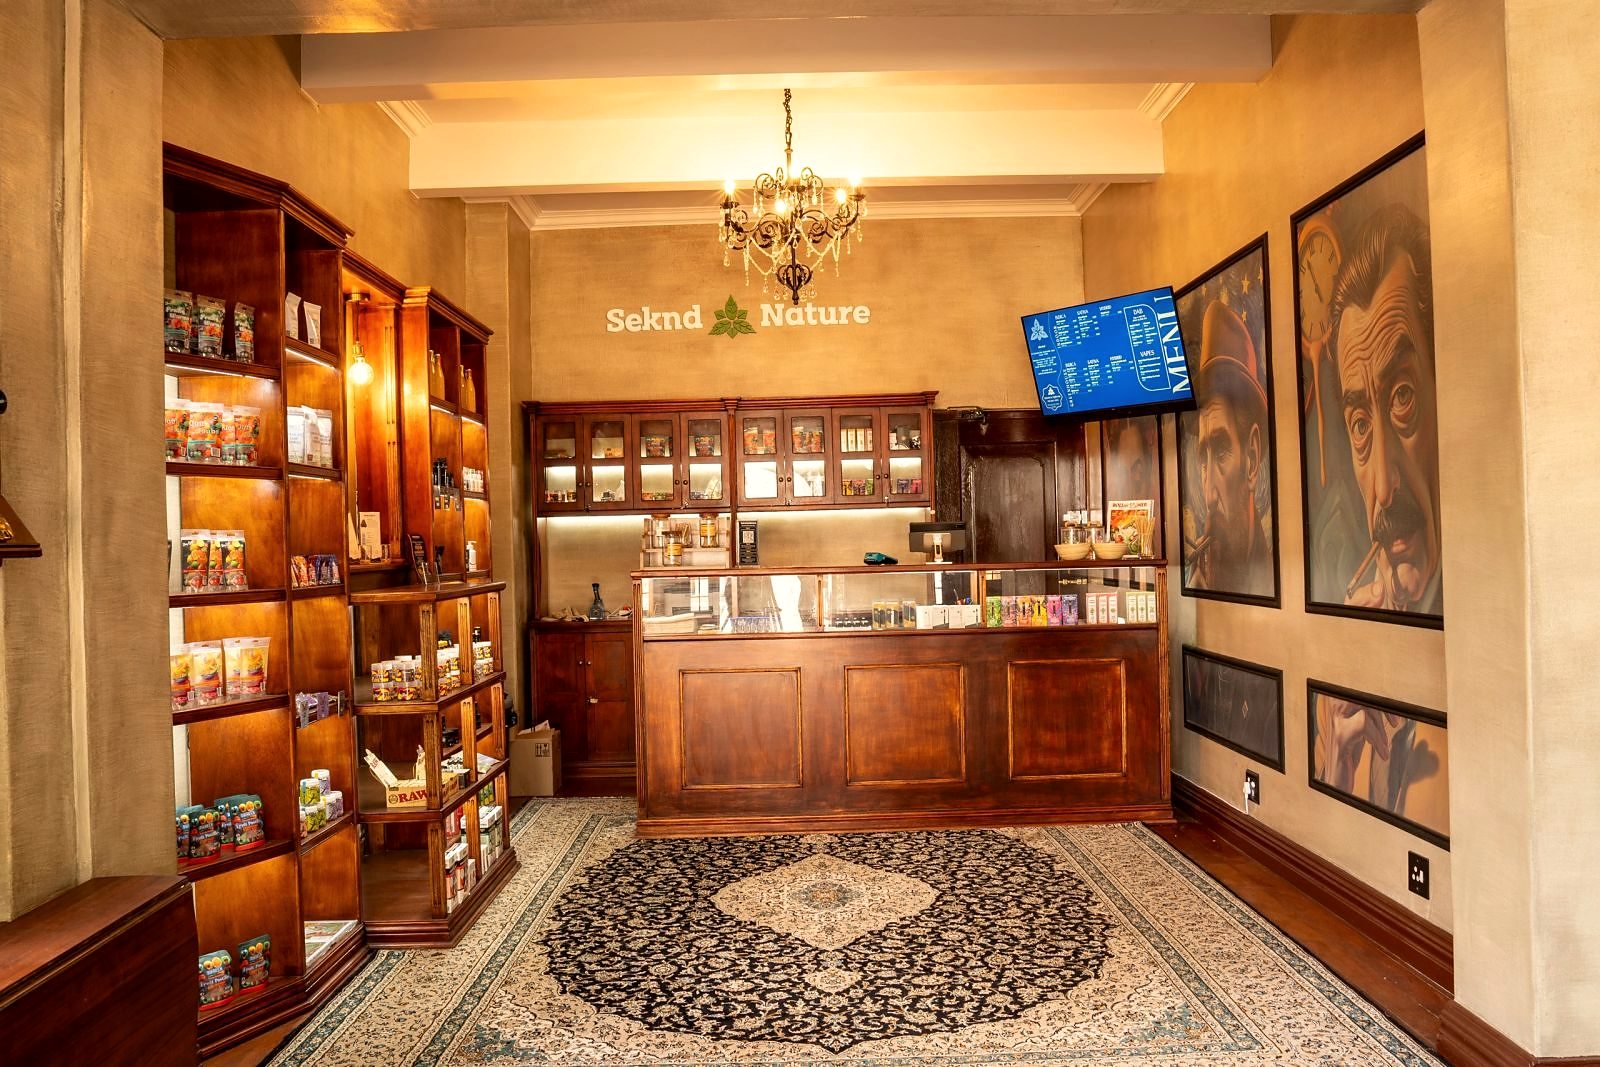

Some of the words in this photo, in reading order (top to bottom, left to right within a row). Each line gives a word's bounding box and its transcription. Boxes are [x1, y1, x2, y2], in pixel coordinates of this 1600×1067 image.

[606, 304, 703, 333] Seknd
[760, 302, 871, 327] Nature
[1140, 349, 1155, 357] VAPES
[1154, 295, 1191, 394] MENU
[398, 789, 428, 803] RAW
